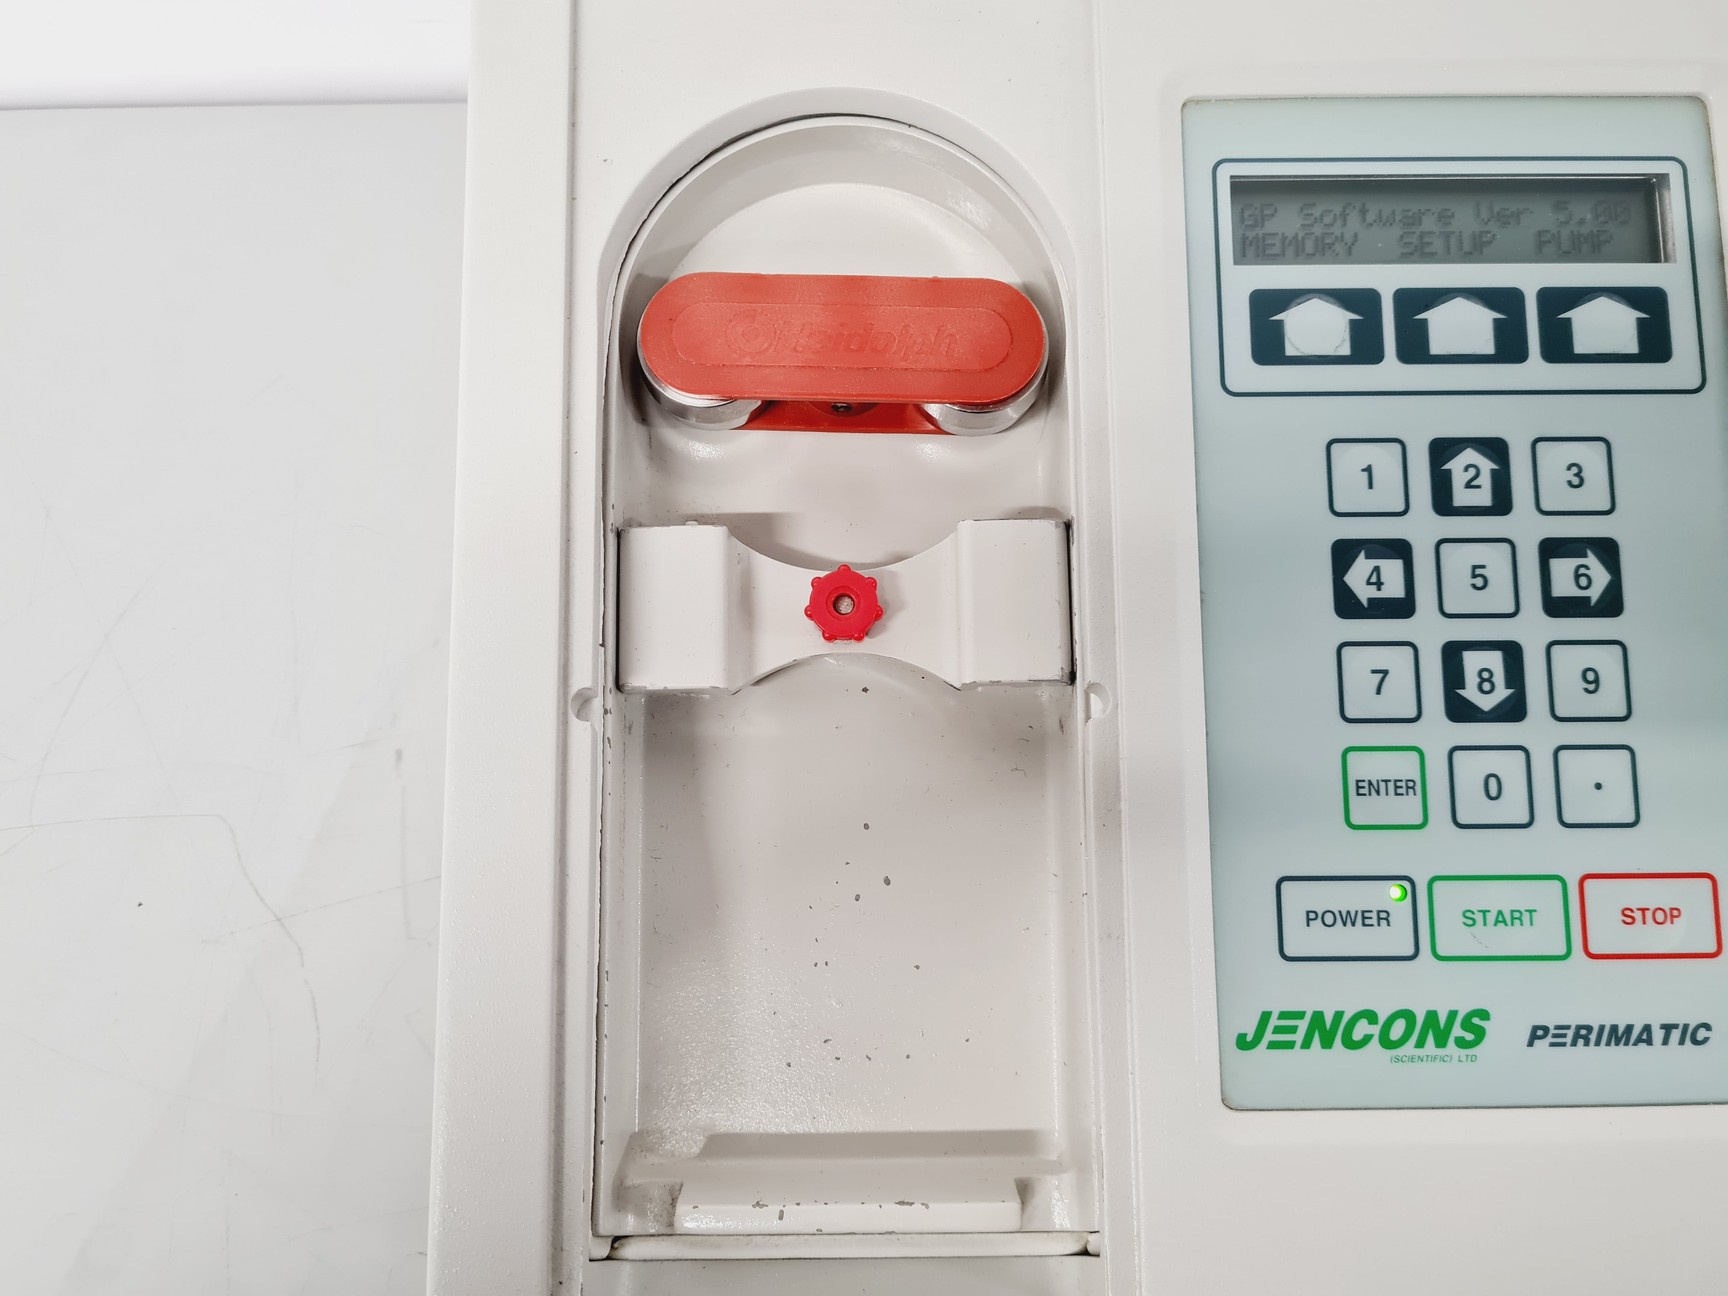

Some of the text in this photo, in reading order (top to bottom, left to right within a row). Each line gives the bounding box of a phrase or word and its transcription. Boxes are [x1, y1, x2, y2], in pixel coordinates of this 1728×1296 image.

[1240, 202, 1279, 229] GP
[1299, 202, 1456, 228] Software
[1474, 201, 1534, 227] Ver
[1240, 229, 1615, 259] MEMORY SETUP PUMP
[1361, 464, 1373, 489] 1
[1463, 463, 1482, 490] 2
[1567, 463, 1584, 489] 3
[1366, 566, 1384, 591] 4
[1471, 565, 1488, 591] 5
[1573, 563, 1592, 590] 6
[1371, 669, 1389, 695] 7
[1477, 668, 1495, 694] 8
[1582, 667, 1600, 694] 9
[1355, 779, 1416, 796] ENTER
[1484, 773, 1502, 801] 0
[1306, 910, 1390, 927] POWER
[1462, 909, 1537, 927] START
[1621, 907, 1681, 925] STOP
[1236, 1009, 1490, 1051] JENCONS
[1527, 1023, 1712, 1047] PERIMATIC
[1390, 1053, 1478, 1064] (SCIENTIFIC) LTD
